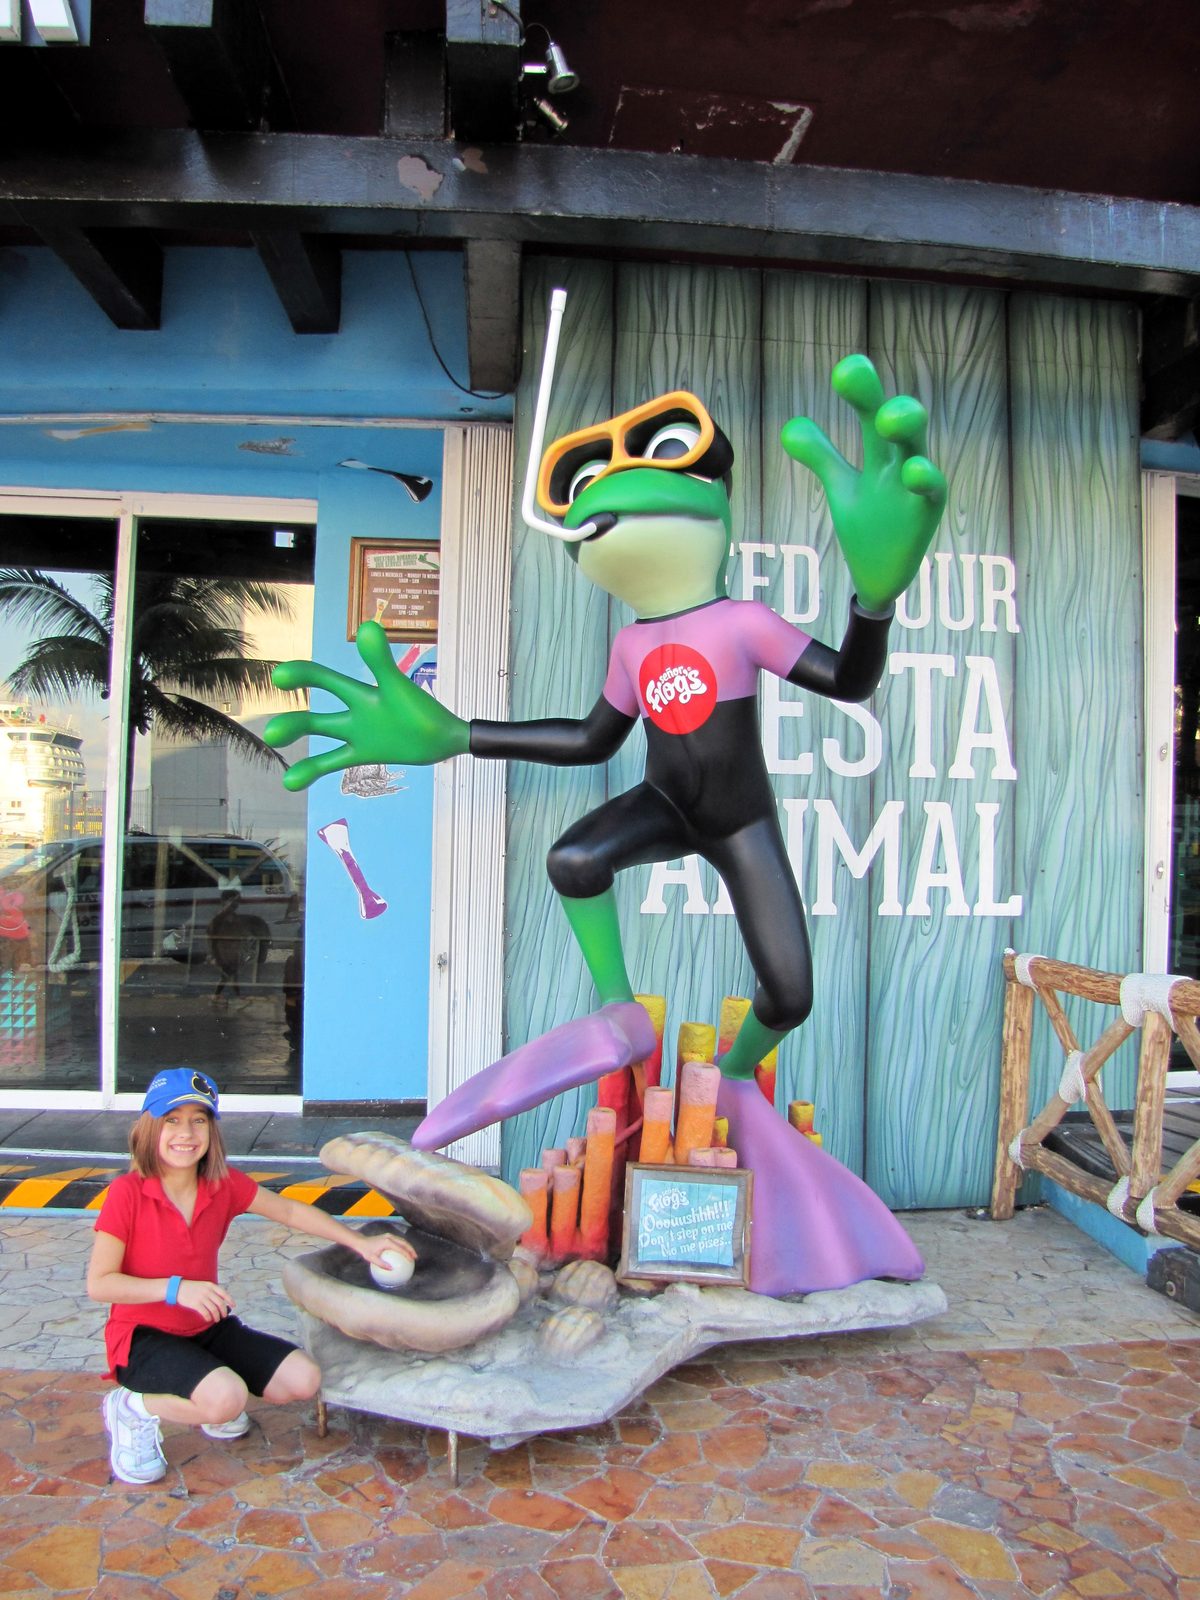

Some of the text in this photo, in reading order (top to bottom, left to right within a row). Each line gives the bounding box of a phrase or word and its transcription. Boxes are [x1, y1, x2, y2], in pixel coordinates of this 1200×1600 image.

[895, 552, 1020, 634] OUR
[761, 652, 1018, 781] ESTA
[660, 1241, 677, 1257] No
[680, 1242, 696, 1254] me
[701, 1224, 715, 1235] on
[717, 1220, 733, 1231] me
